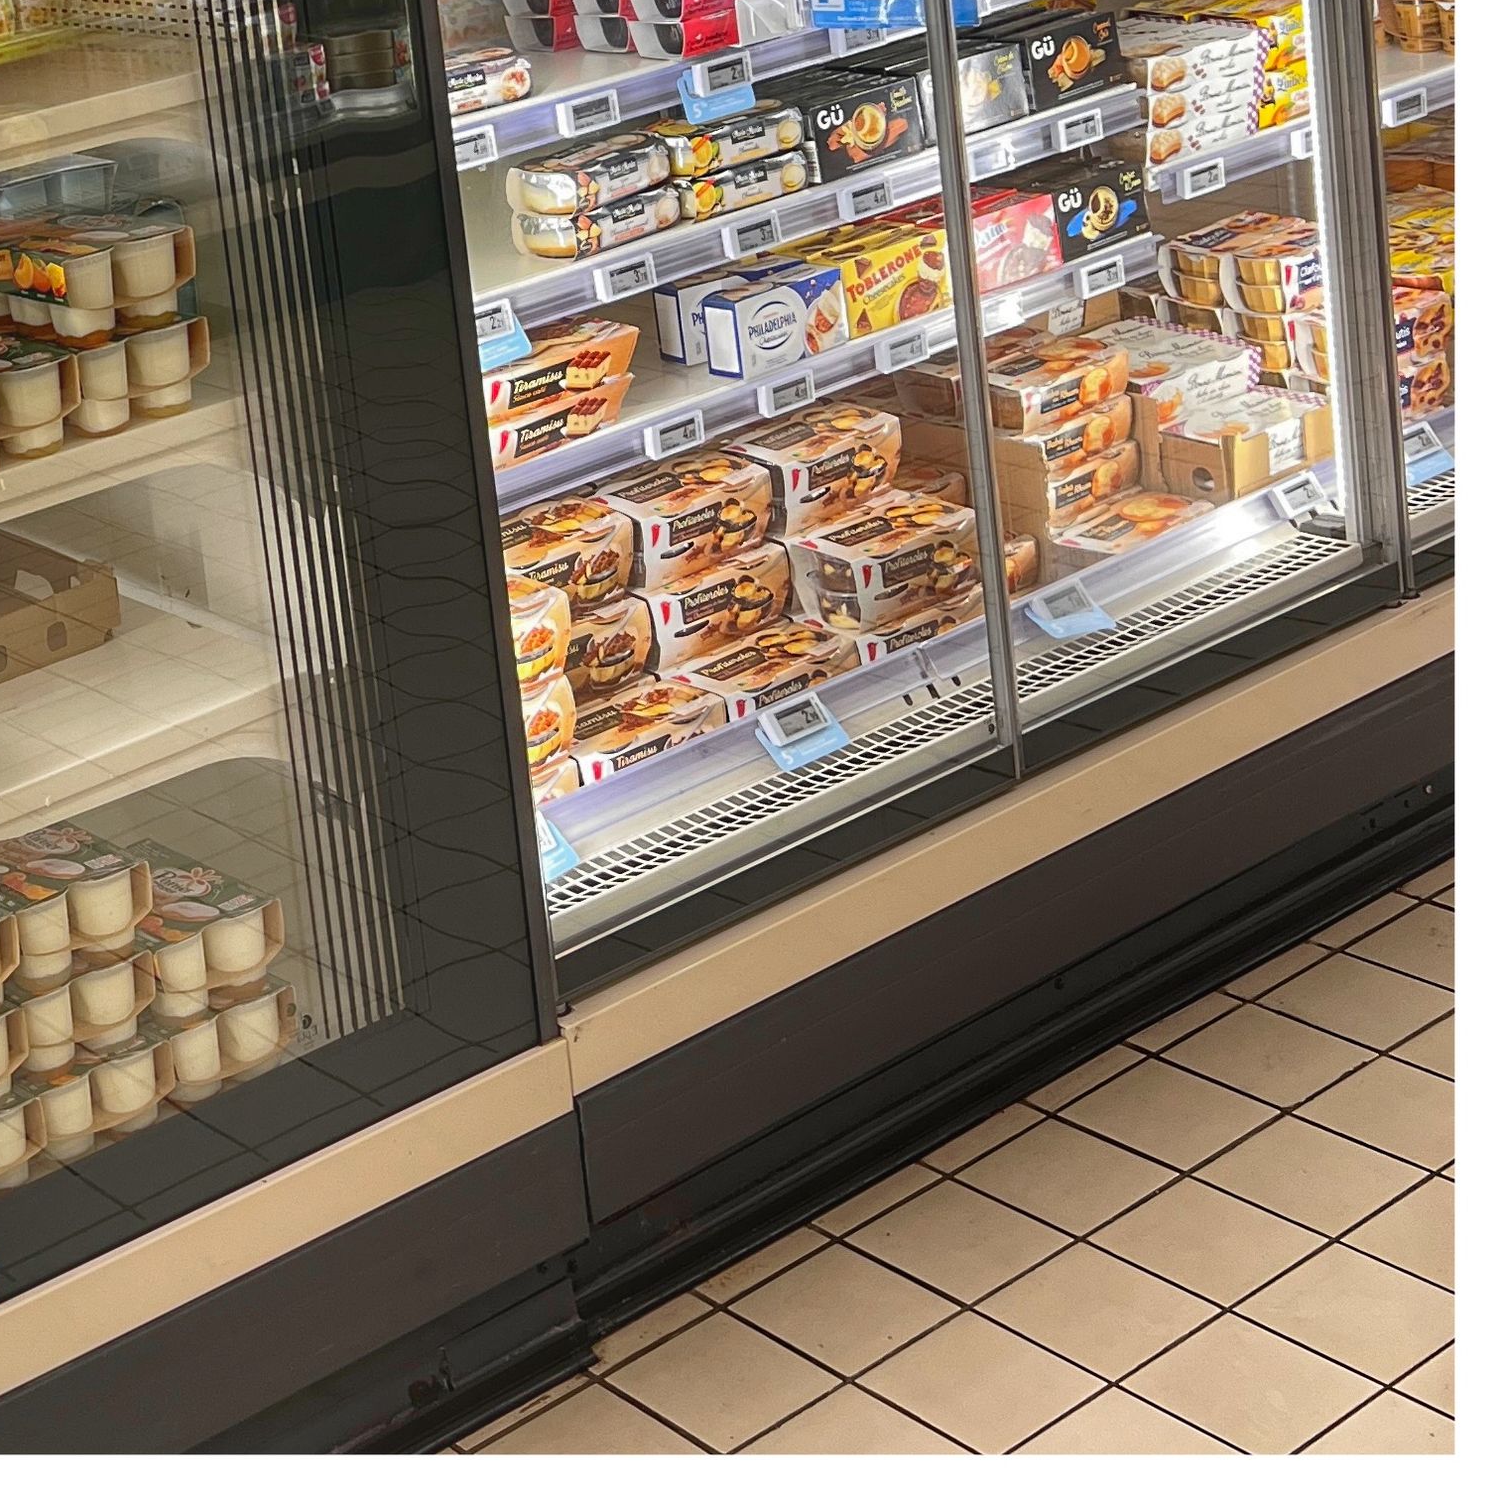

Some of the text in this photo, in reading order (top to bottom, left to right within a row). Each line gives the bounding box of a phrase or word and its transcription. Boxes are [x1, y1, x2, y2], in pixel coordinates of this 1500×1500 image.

[1031, 35, 1055, 61] GÜ
[816, 104, 844, 130] GÜ
[1057, 187, 1082, 214] GÜ
[846, 245, 922, 302] TOBLERONE
[747, 312, 797, 339] PHILADELPHIA
